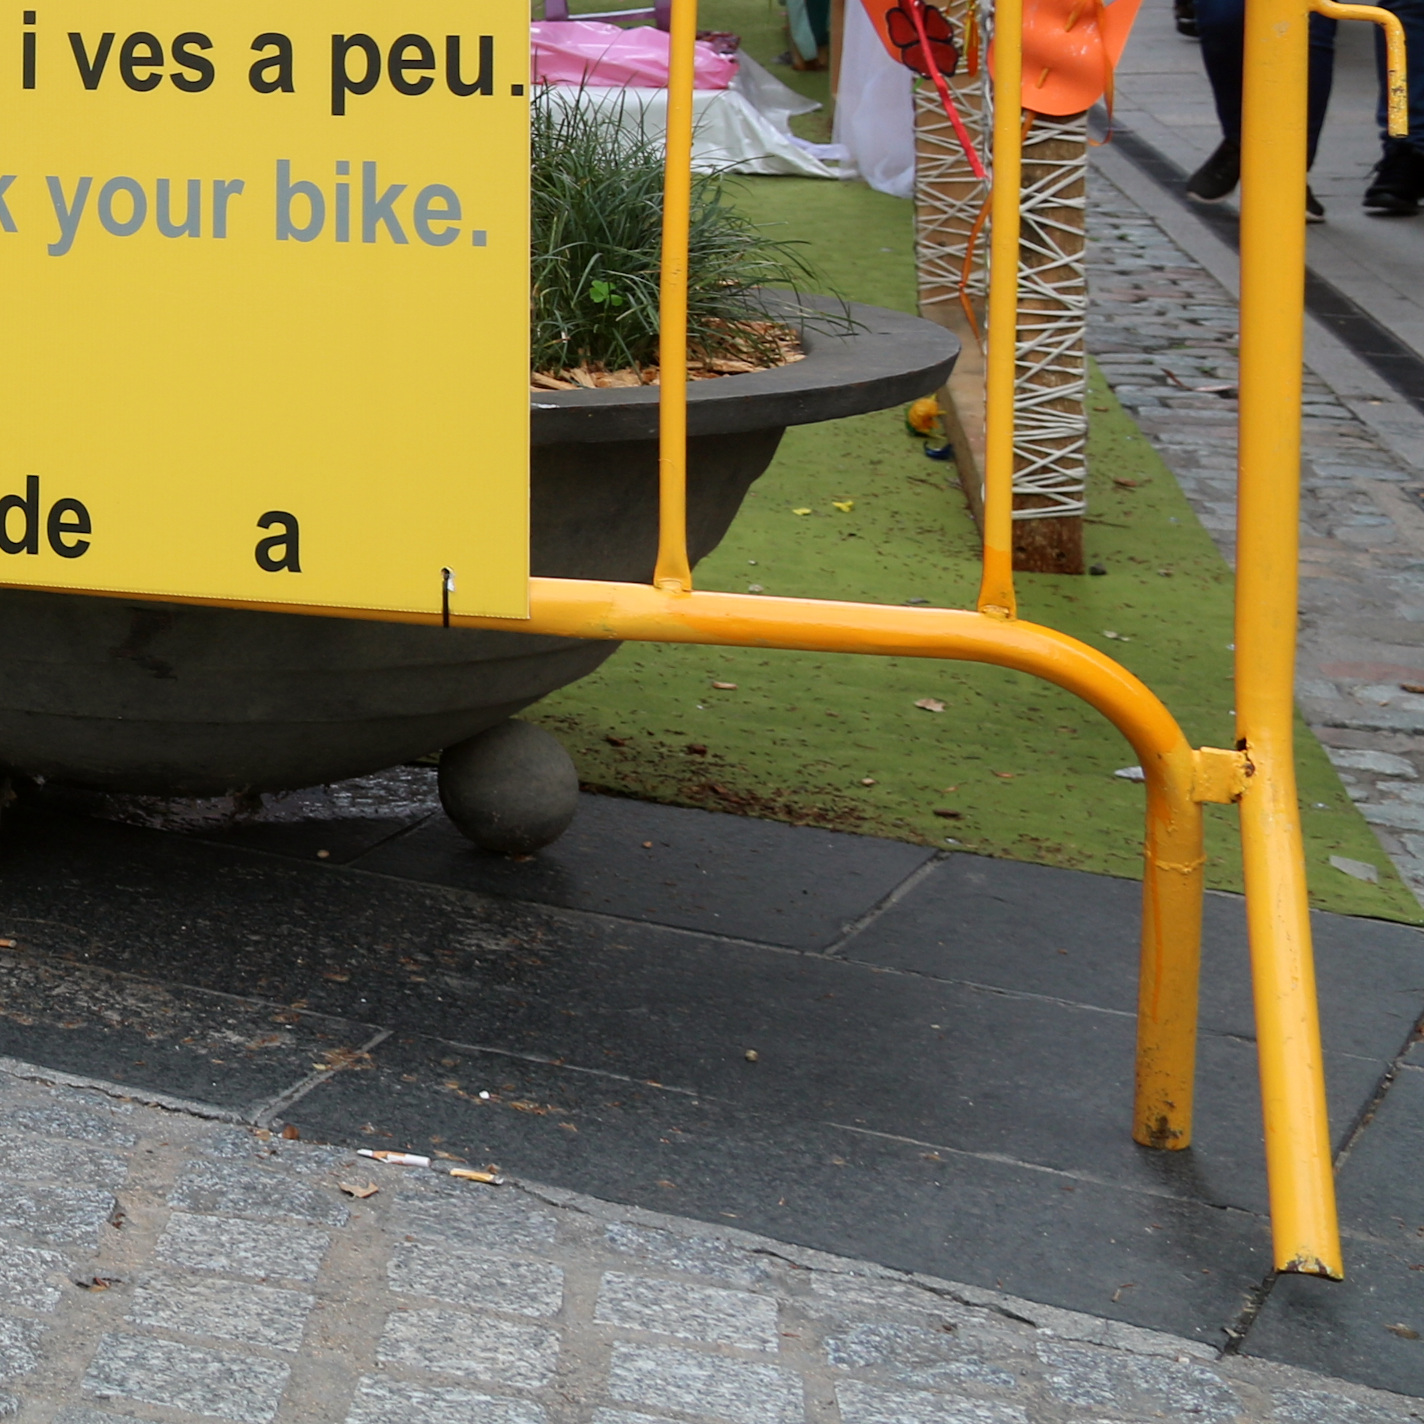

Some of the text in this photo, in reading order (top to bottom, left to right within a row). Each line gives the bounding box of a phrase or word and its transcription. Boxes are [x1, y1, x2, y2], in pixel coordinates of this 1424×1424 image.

[22, 10, 37, 91] i
[67, 31, 215, 93] ves
[248, 32, 296, 94] a
[331, 33, 525, 116] peu.
[46, 175, 245, 257] your
[276, 158, 488, 247] bike.
[254, 510, 302, 574] a
